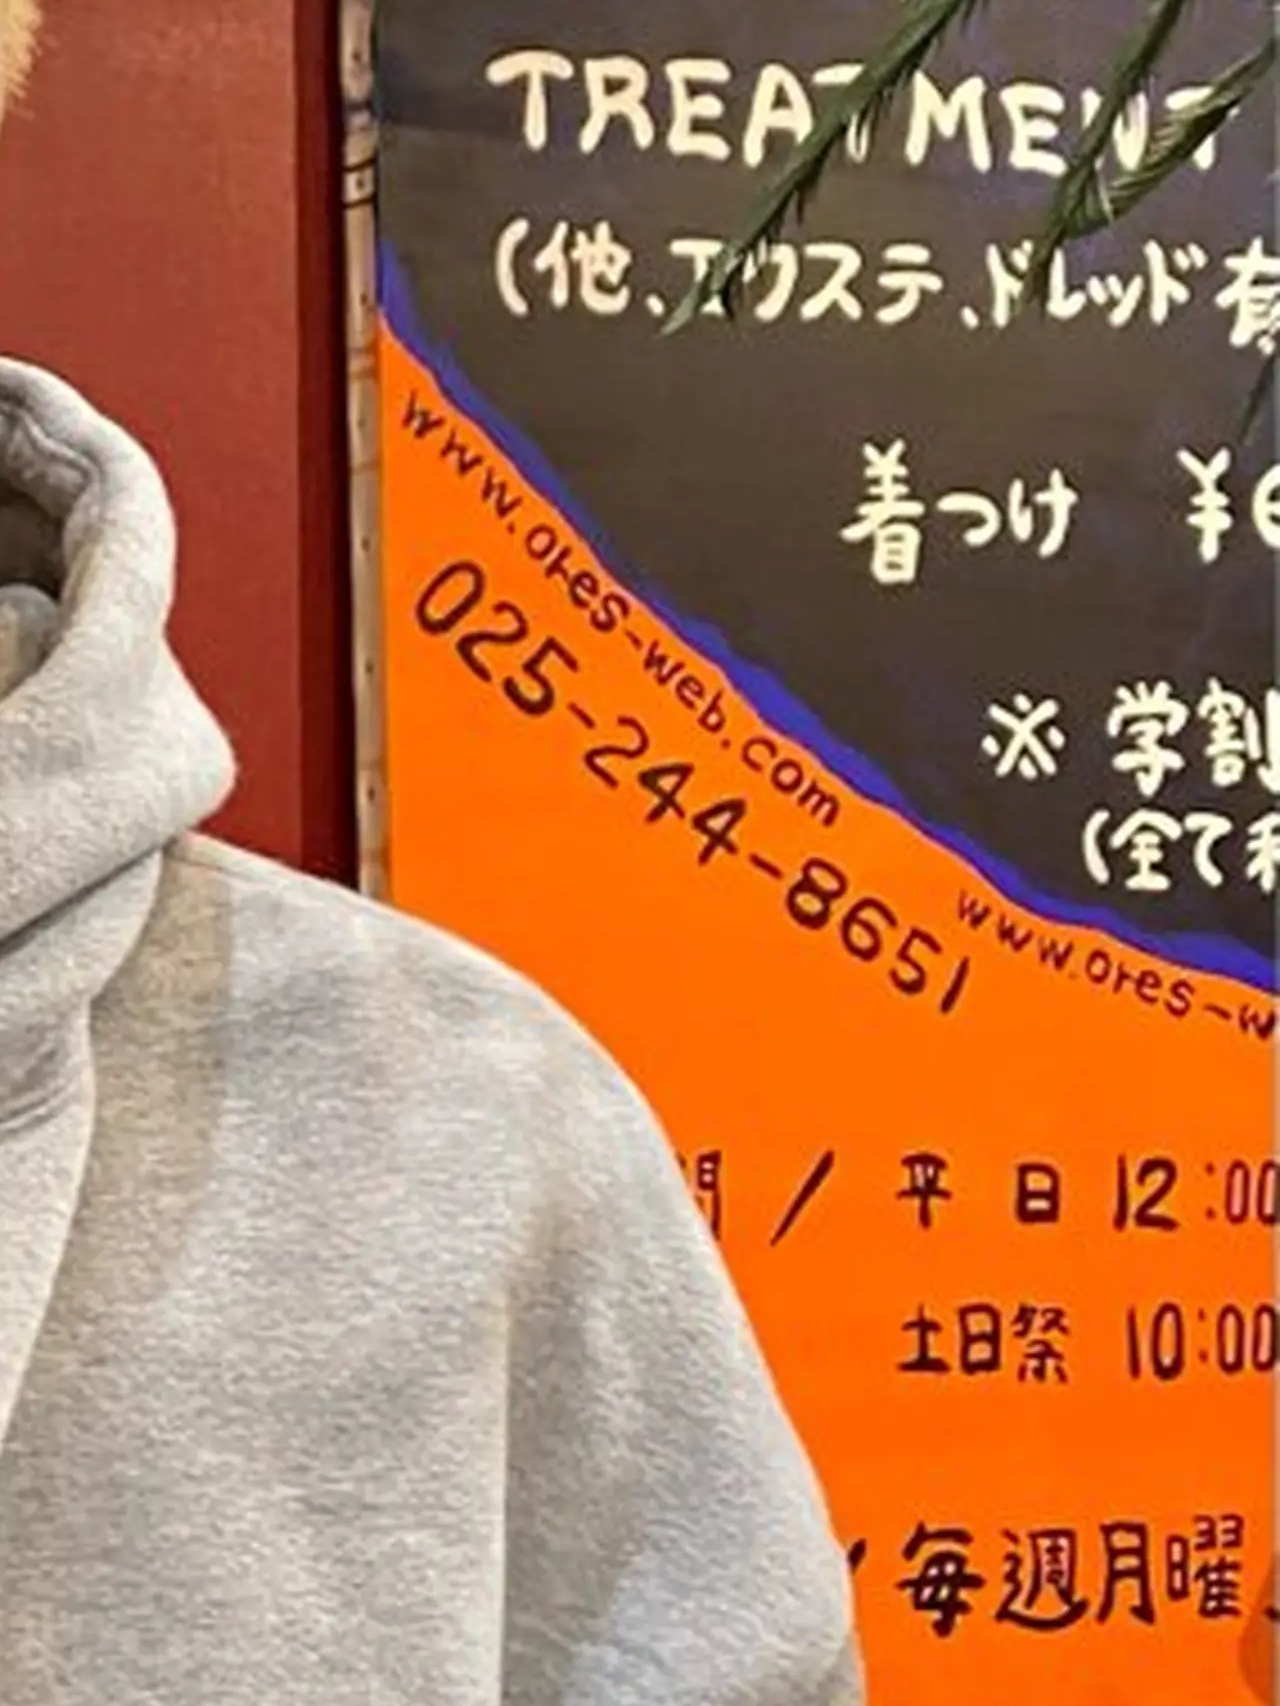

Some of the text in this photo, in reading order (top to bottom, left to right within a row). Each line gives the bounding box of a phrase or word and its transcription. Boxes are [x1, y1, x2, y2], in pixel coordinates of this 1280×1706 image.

[401, 389, 841, 828] www.ores-web.com
[839, 437, 1080, 585] 着つけ
[415, 560, 969, 1017] 025-244-8651
[896, 1302, 1280, 1384] 土日祭 10:00
